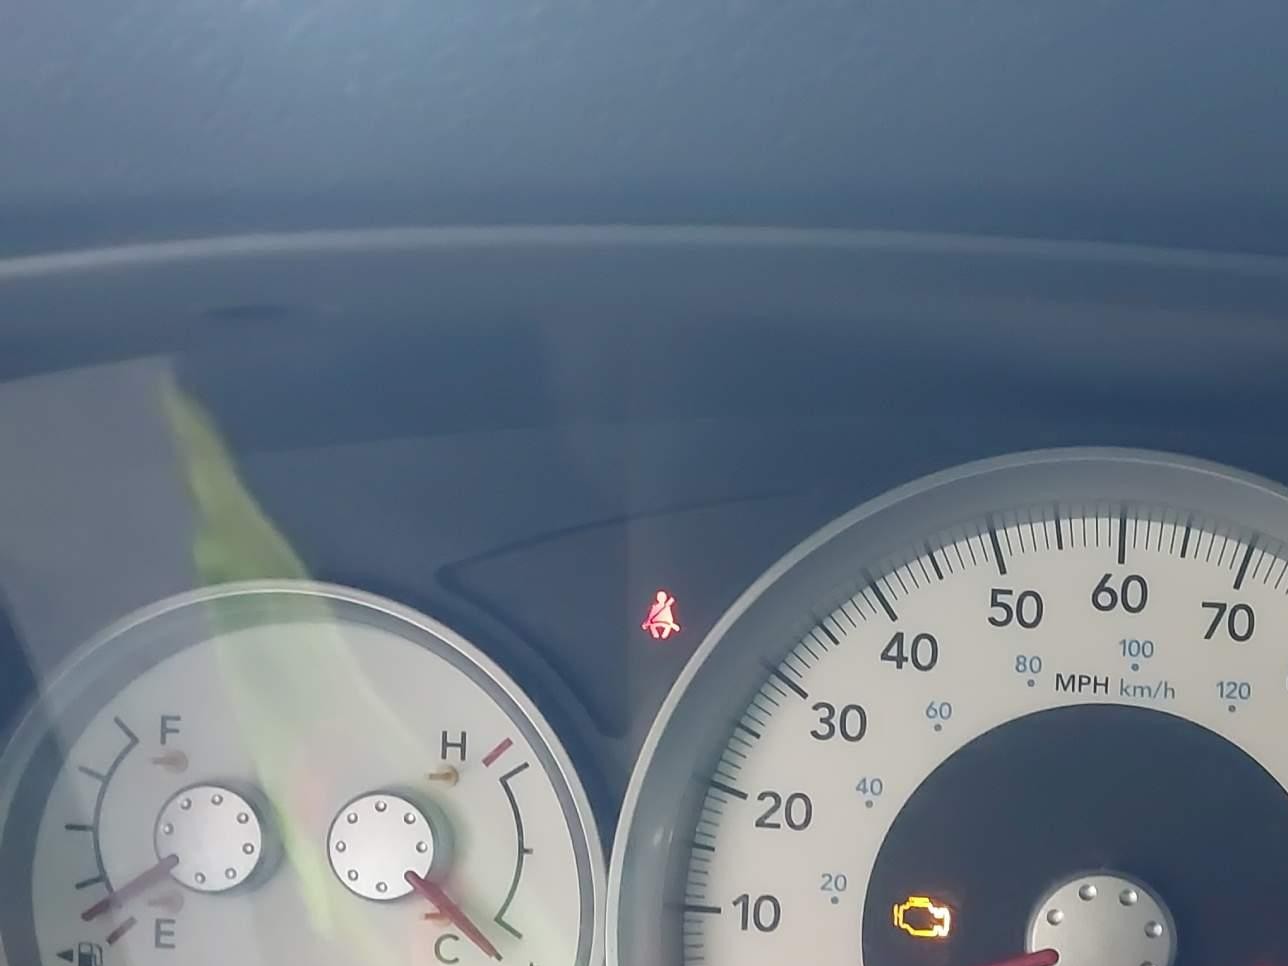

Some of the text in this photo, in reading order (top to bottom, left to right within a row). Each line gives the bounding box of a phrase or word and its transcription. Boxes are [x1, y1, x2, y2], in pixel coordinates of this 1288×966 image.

[987, 588, 1044, 629] 50
[1091, 573, 1149, 614] 60
[1201, 601, 1256, 642] 70
[880, 632, 939, 671] 40
[1119, 639, 1155, 658] 100
[1015, 656, 1042, 674] 80
[1054, 673, 1176, 700] MPH km/h
[1216, 681, 1251, 700] 120
[810, 702, 867, 742] 30
[925, 702, 952, 721] 60
[160, 715, 182, 745] F
[442, 731, 468, 760] H
[855, 778, 883, 797] 40
[754, 791, 813, 831] 20
[820, 873, 847, 892] 20
[731, 894, 781, 932] 10
[154, 918, 176, 949] E
[434, 933, 460, 964] C
